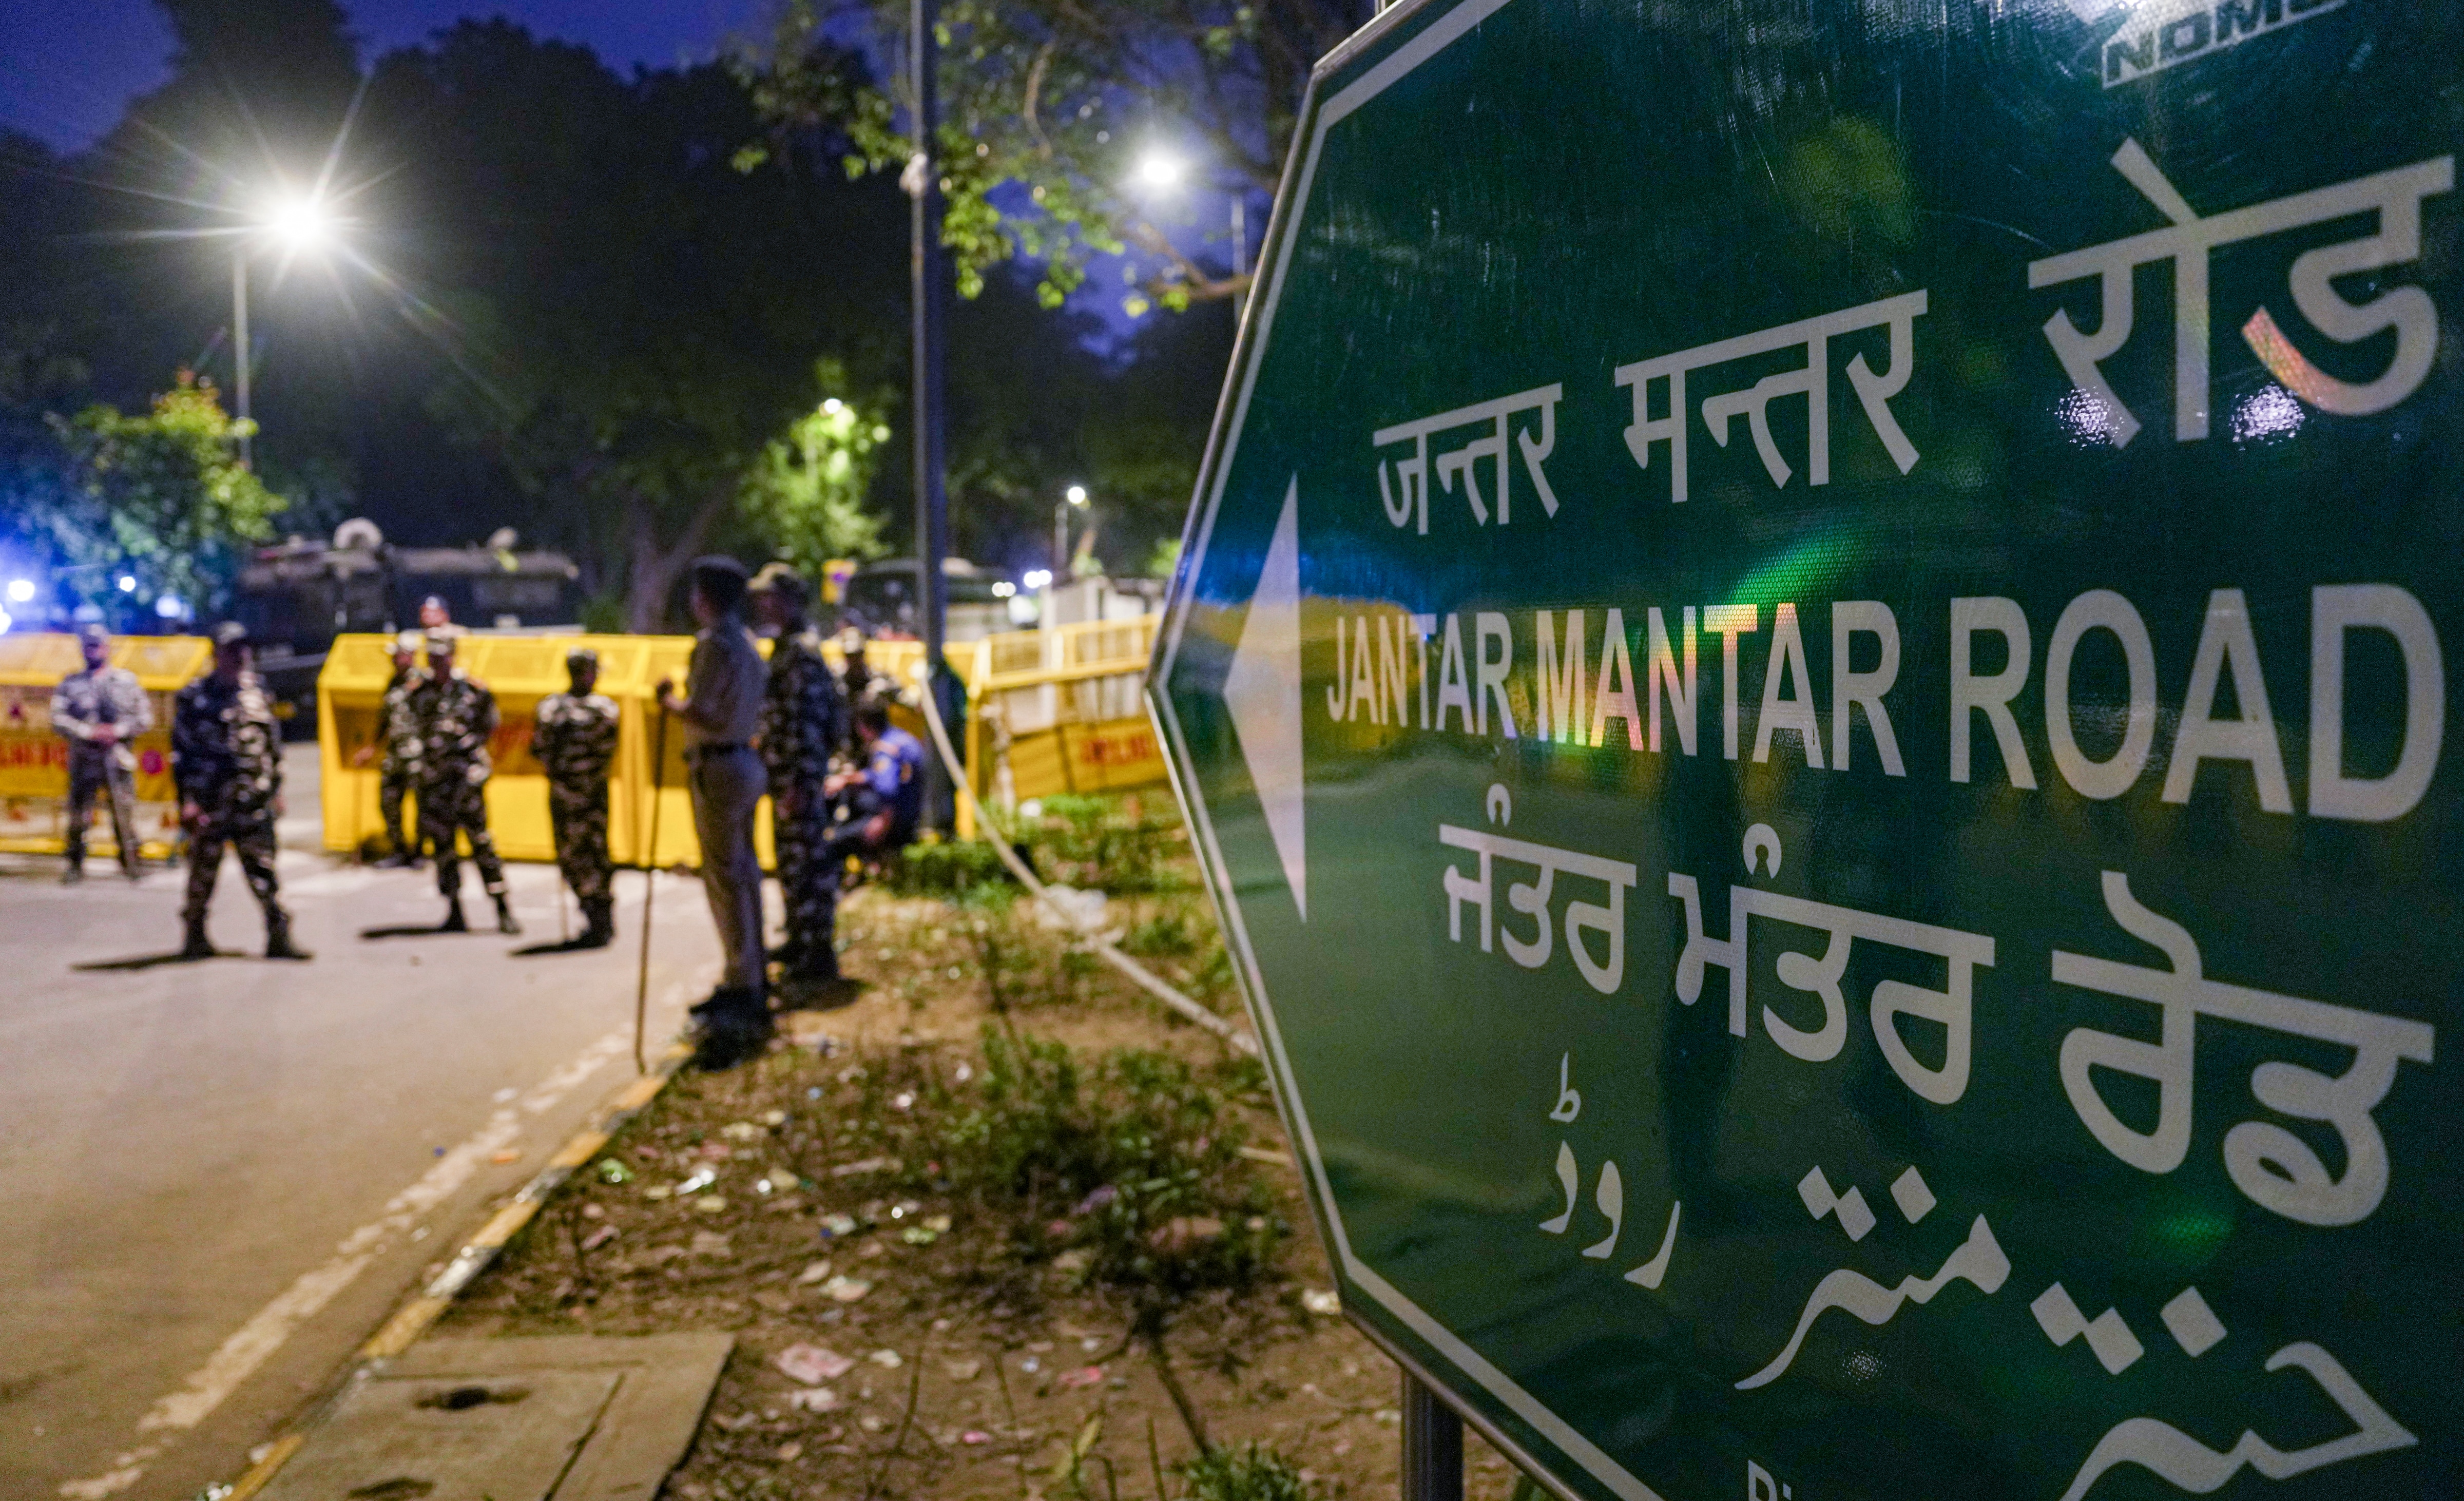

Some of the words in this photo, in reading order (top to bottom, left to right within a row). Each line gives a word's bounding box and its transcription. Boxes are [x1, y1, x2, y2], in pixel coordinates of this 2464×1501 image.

[1373, 382, 1562, 535] जन्तर
[1614, 288, 1928, 503] मन्तर
[2028, 136, 2455, 450] रोड
[1327, 611, 1516, 739] JANTAR
[1536, 600, 1908, 777] MANTAR
[1949, 583, 2446, 821] ROAD
[1439, 783, 1637, 995] ਜੰਤਰ
[1668, 822, 1996, 1105] ਮੰਤਰ
